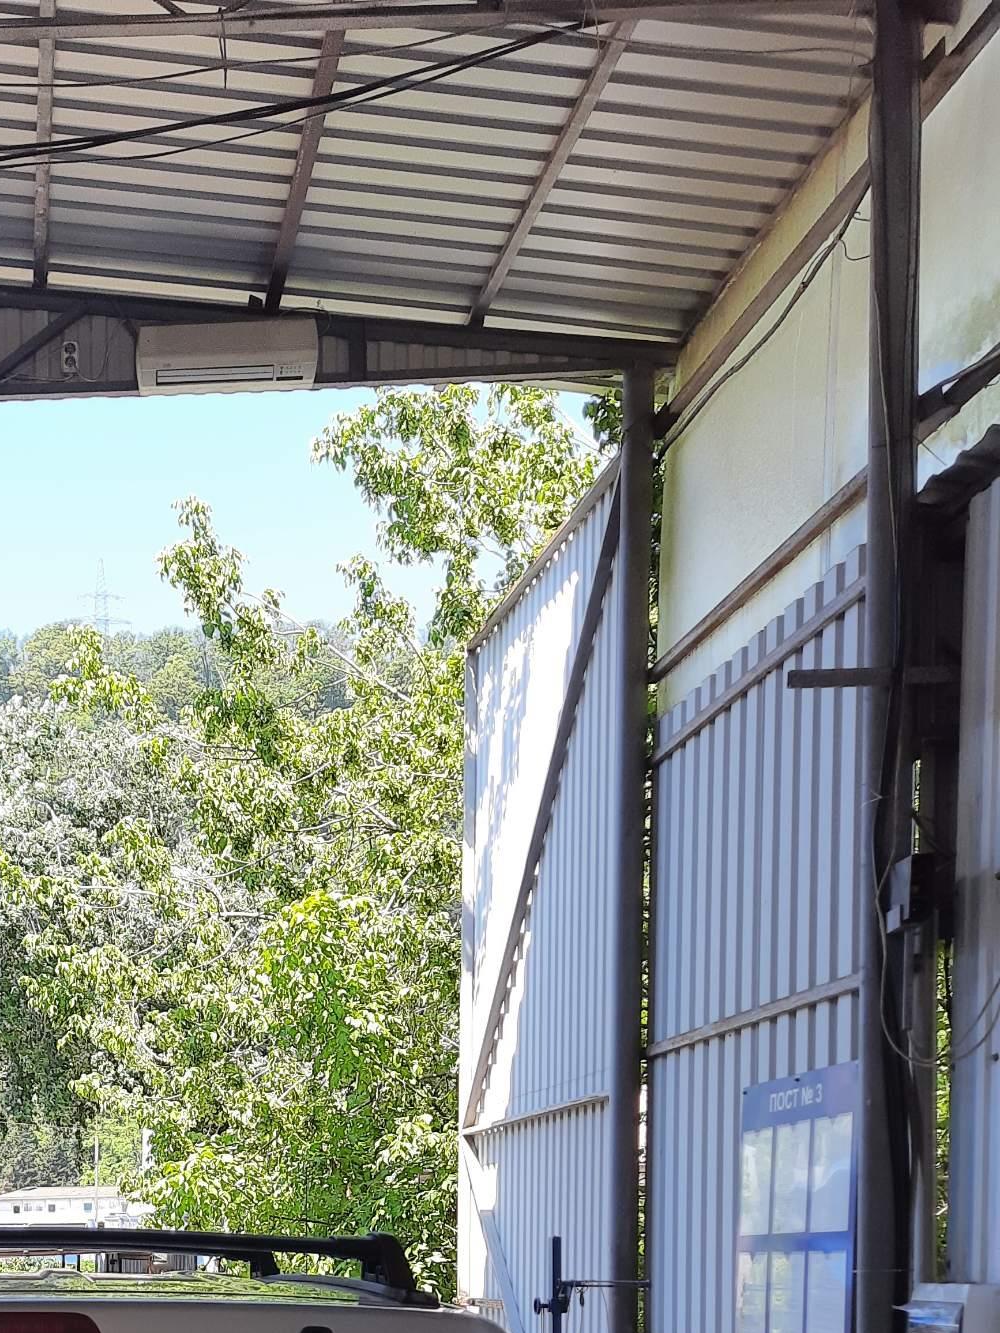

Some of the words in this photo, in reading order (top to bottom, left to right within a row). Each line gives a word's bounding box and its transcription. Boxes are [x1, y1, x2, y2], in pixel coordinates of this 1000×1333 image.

[769, 1088, 799, 1112] ПОСТ
[801, 1086, 814, 1107] №
[815, 1083, 823, 1104] 3
